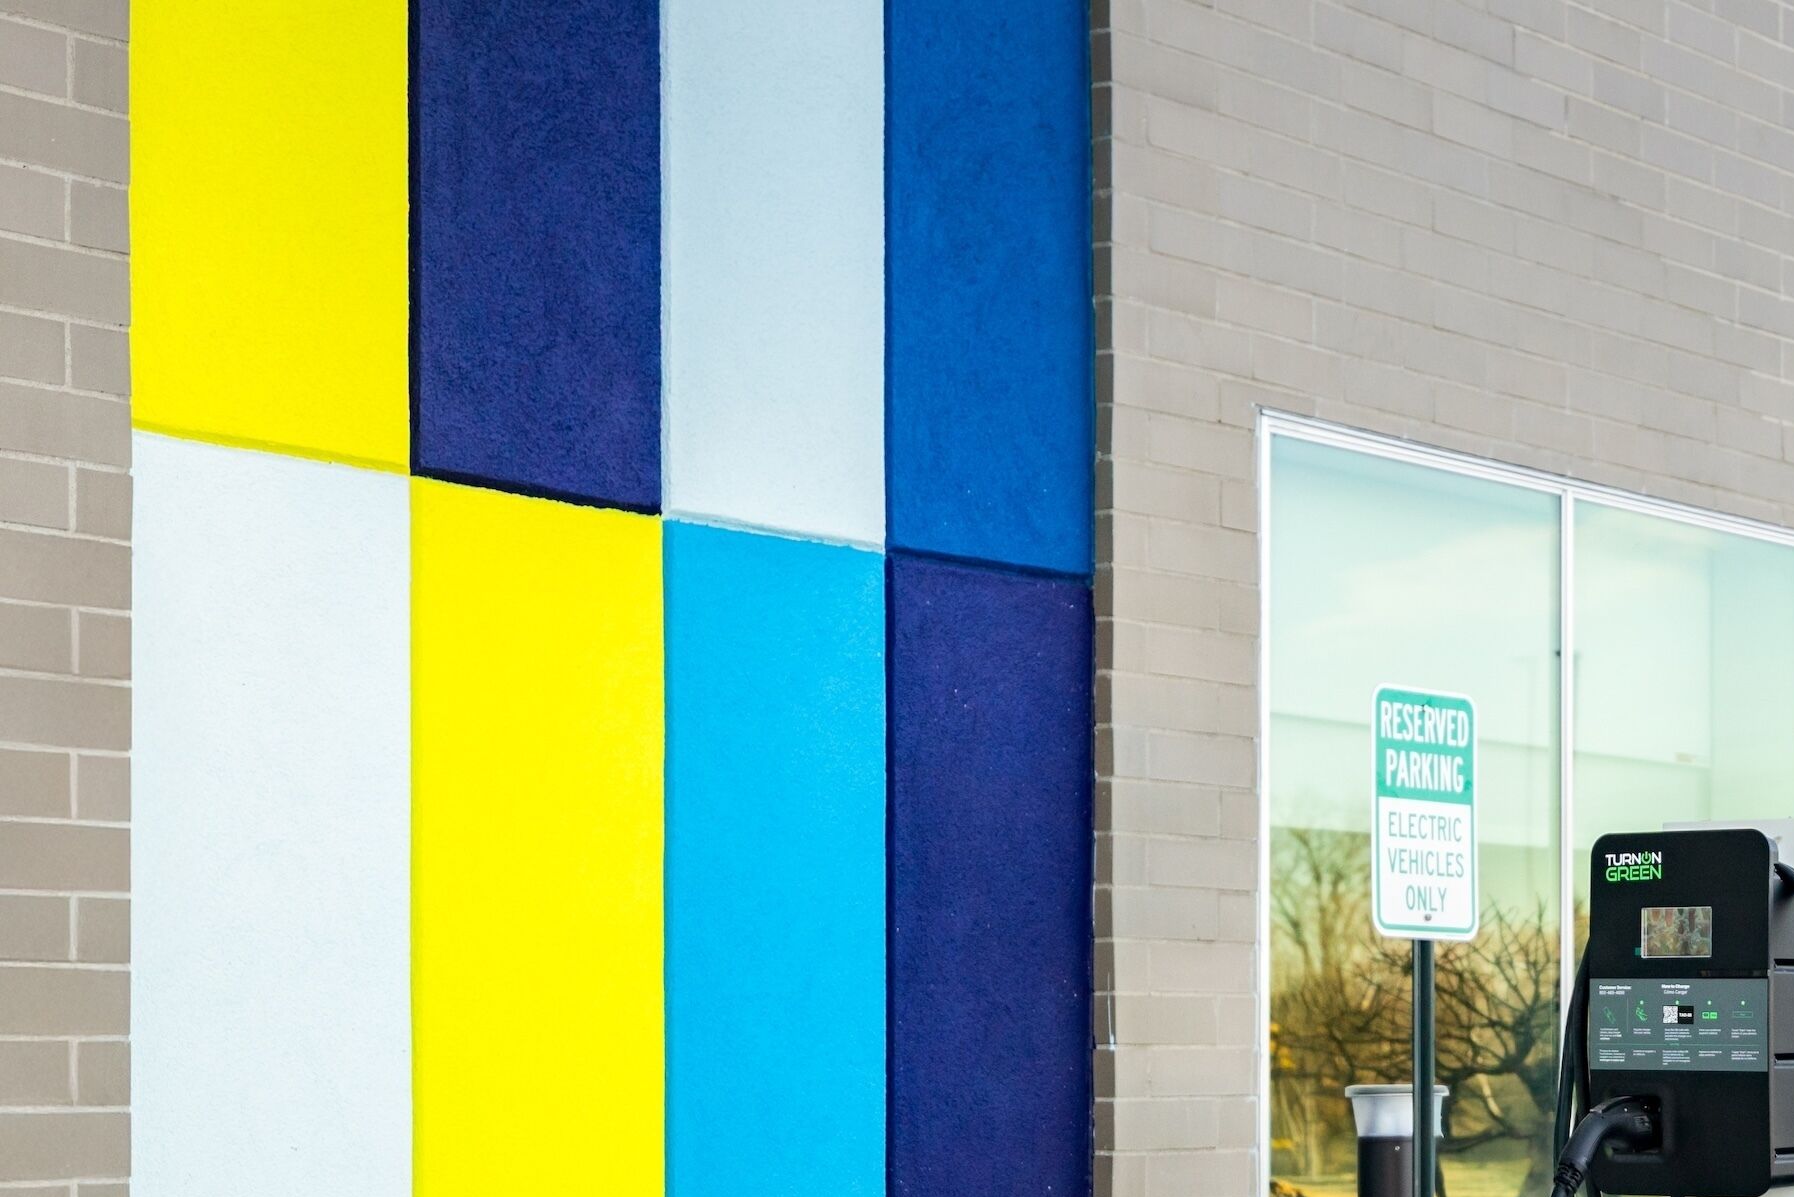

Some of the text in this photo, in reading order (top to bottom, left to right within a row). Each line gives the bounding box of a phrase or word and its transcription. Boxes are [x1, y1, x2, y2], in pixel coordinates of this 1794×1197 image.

[1380, 700, 1470, 748] RESERVED
[1385, 748, 1464, 793] PARKING
[1388, 811, 1463, 842] ELECTRIC
[1387, 848, 1465, 878] VEHICLES
[1605, 851, 1662, 866] TURNON
[1605, 865, 1662, 881] GREEN
[1405, 884, 1448, 913] ONLY
